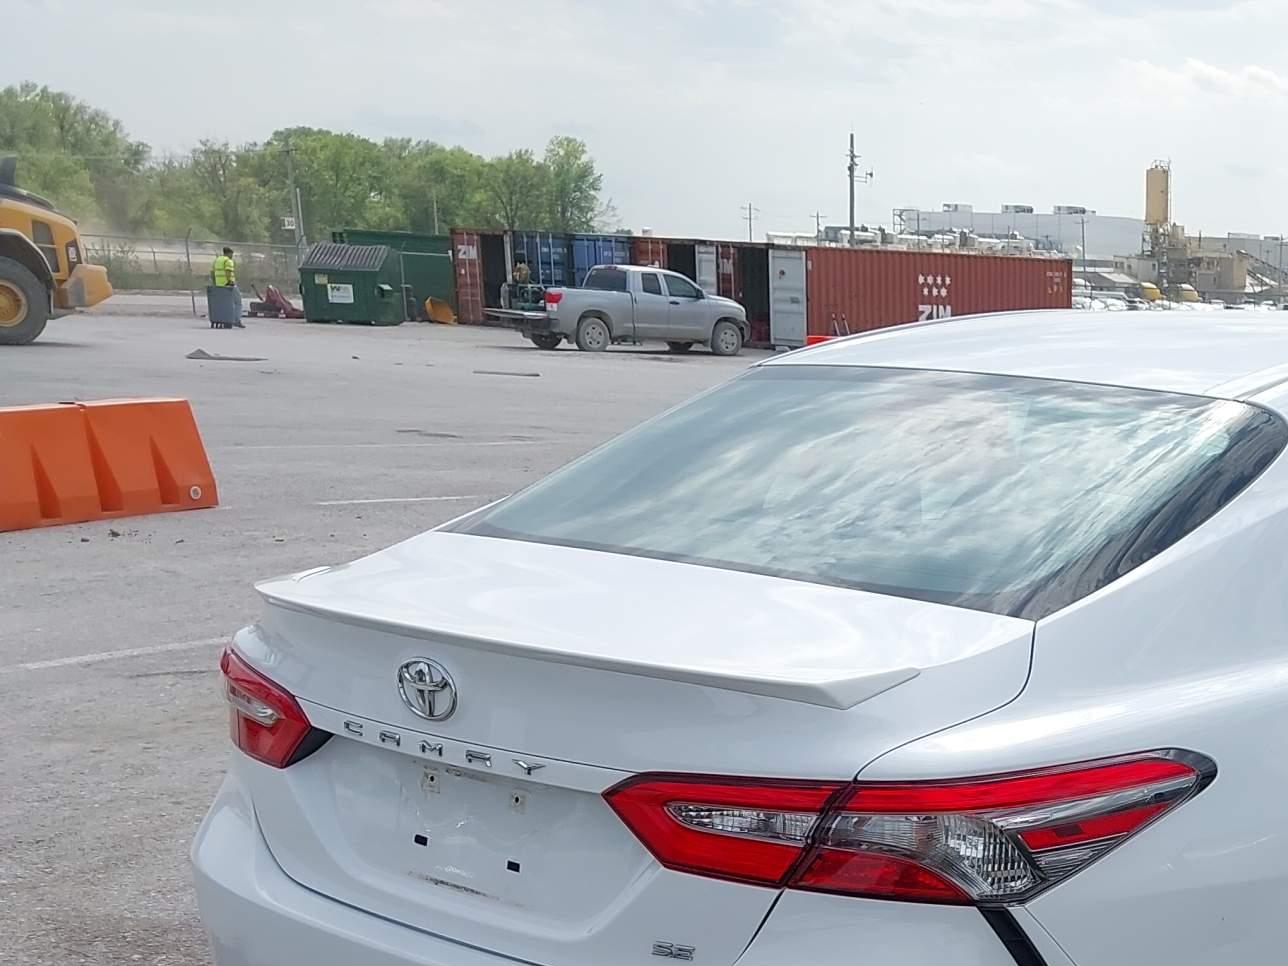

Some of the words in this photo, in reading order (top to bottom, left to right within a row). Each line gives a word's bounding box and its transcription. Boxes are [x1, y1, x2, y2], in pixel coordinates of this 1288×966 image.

[918, 304, 952, 322] ZIM
[343, 719, 548, 776] CAMRY
[651, 940, 696, 961] SE
